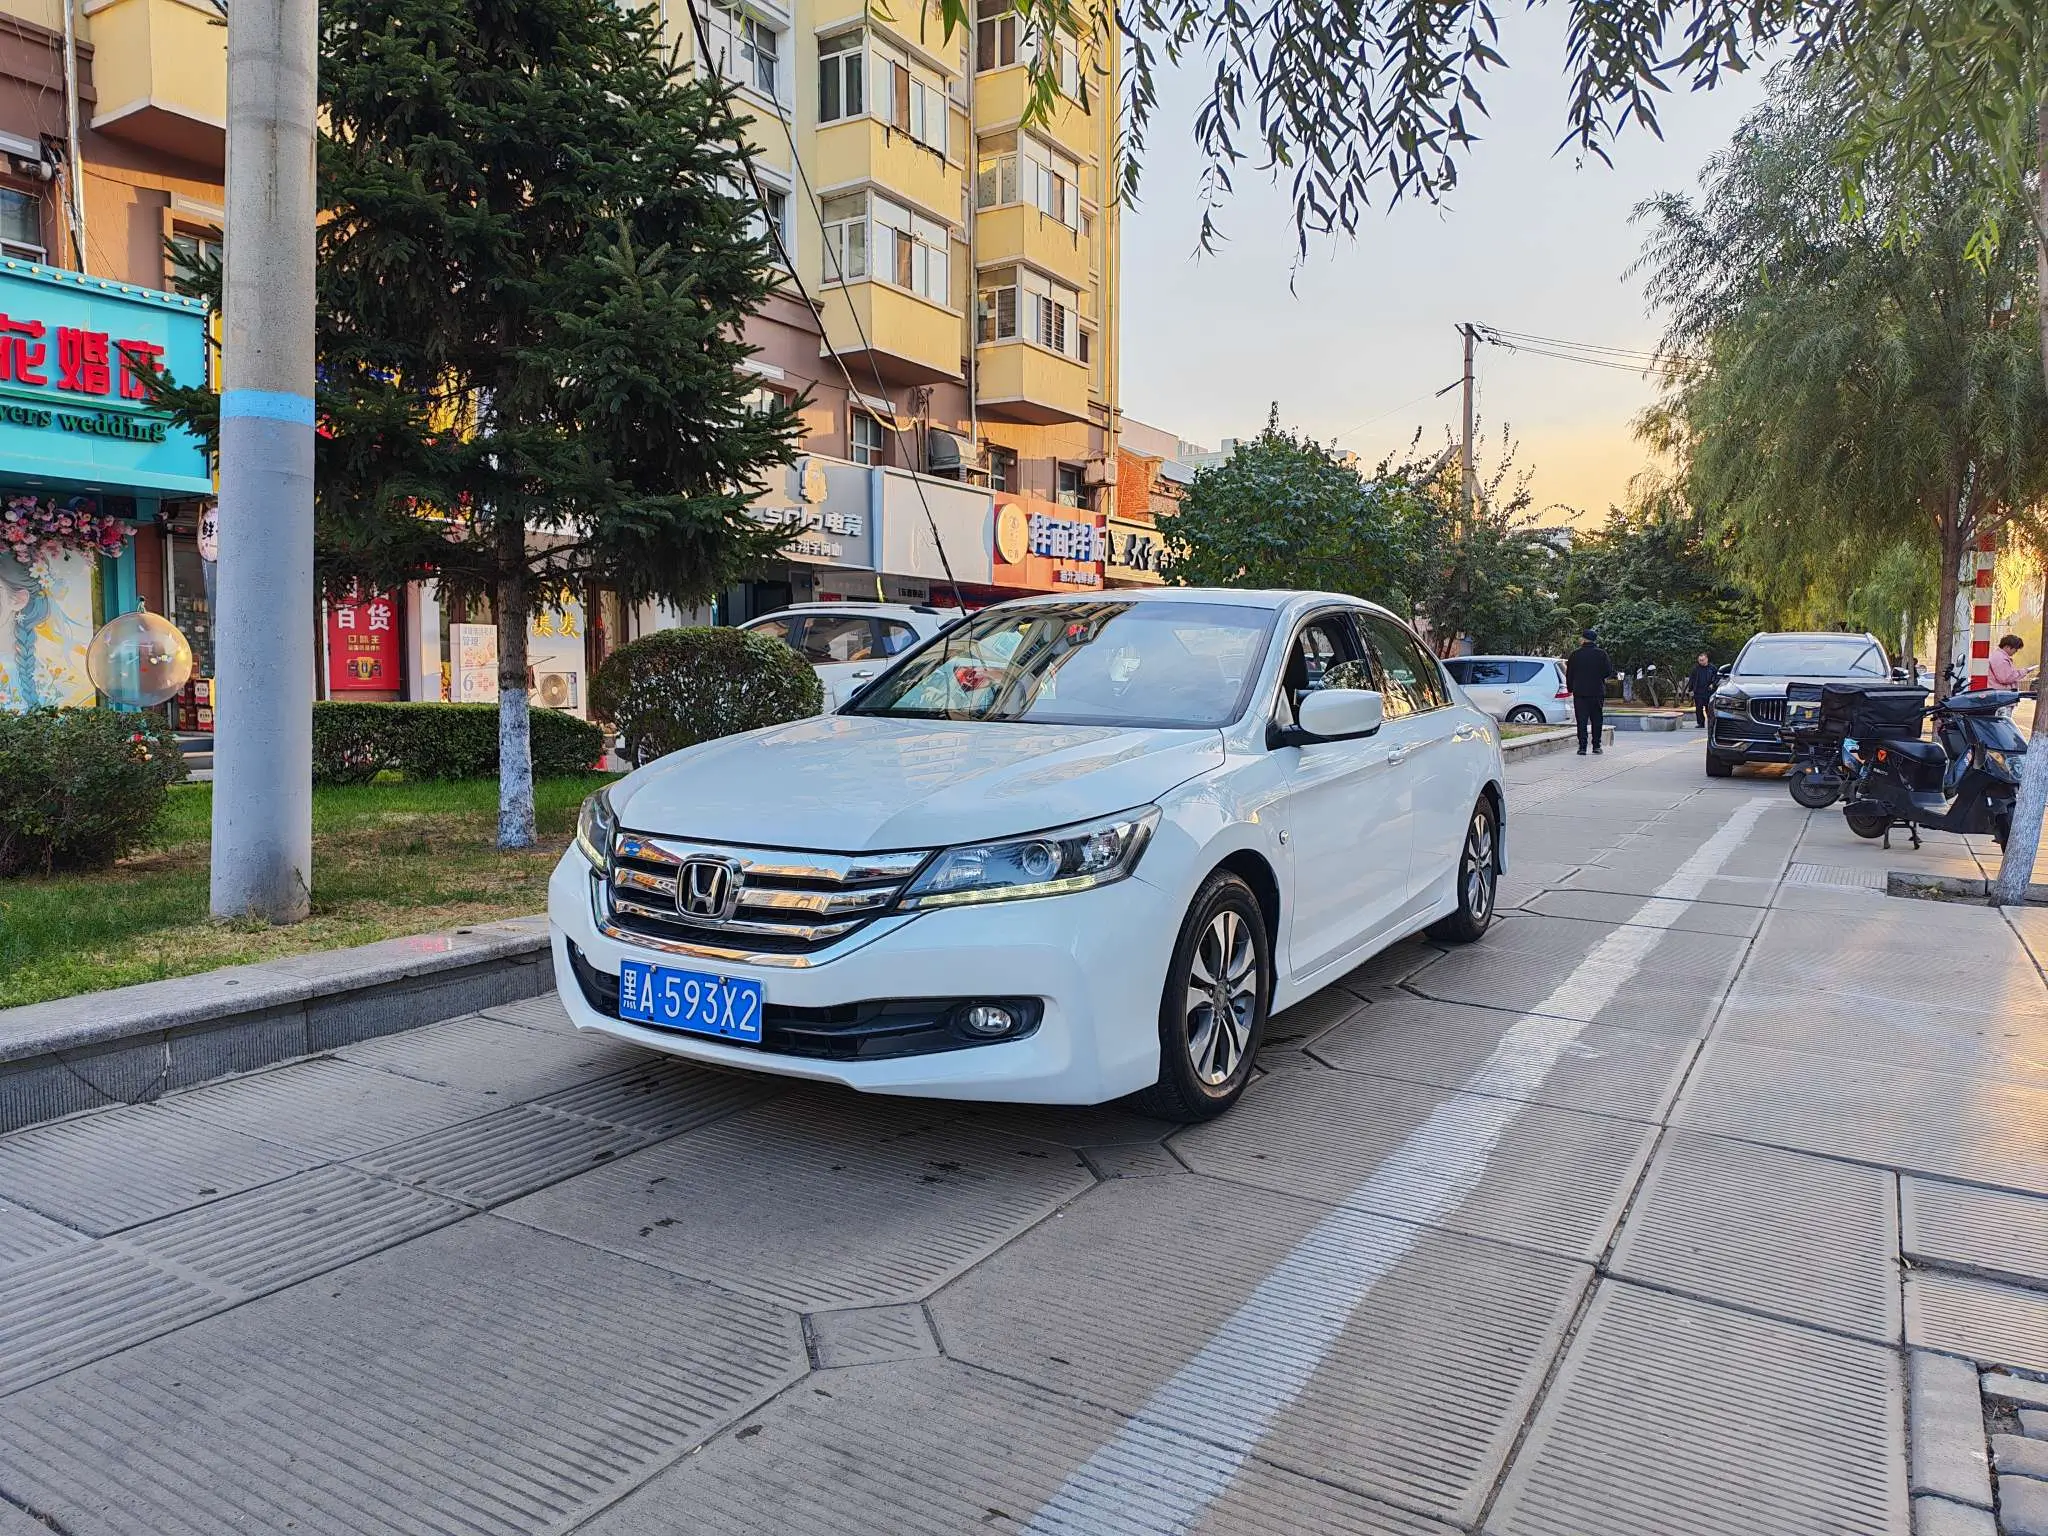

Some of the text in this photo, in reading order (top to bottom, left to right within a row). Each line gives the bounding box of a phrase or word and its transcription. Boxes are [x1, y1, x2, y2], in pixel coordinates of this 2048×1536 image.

[57, 412, 167, 443] wedding
[1029, 512, 1106, 563] 拌面拌饭
[336, 604, 391, 631] 百货
